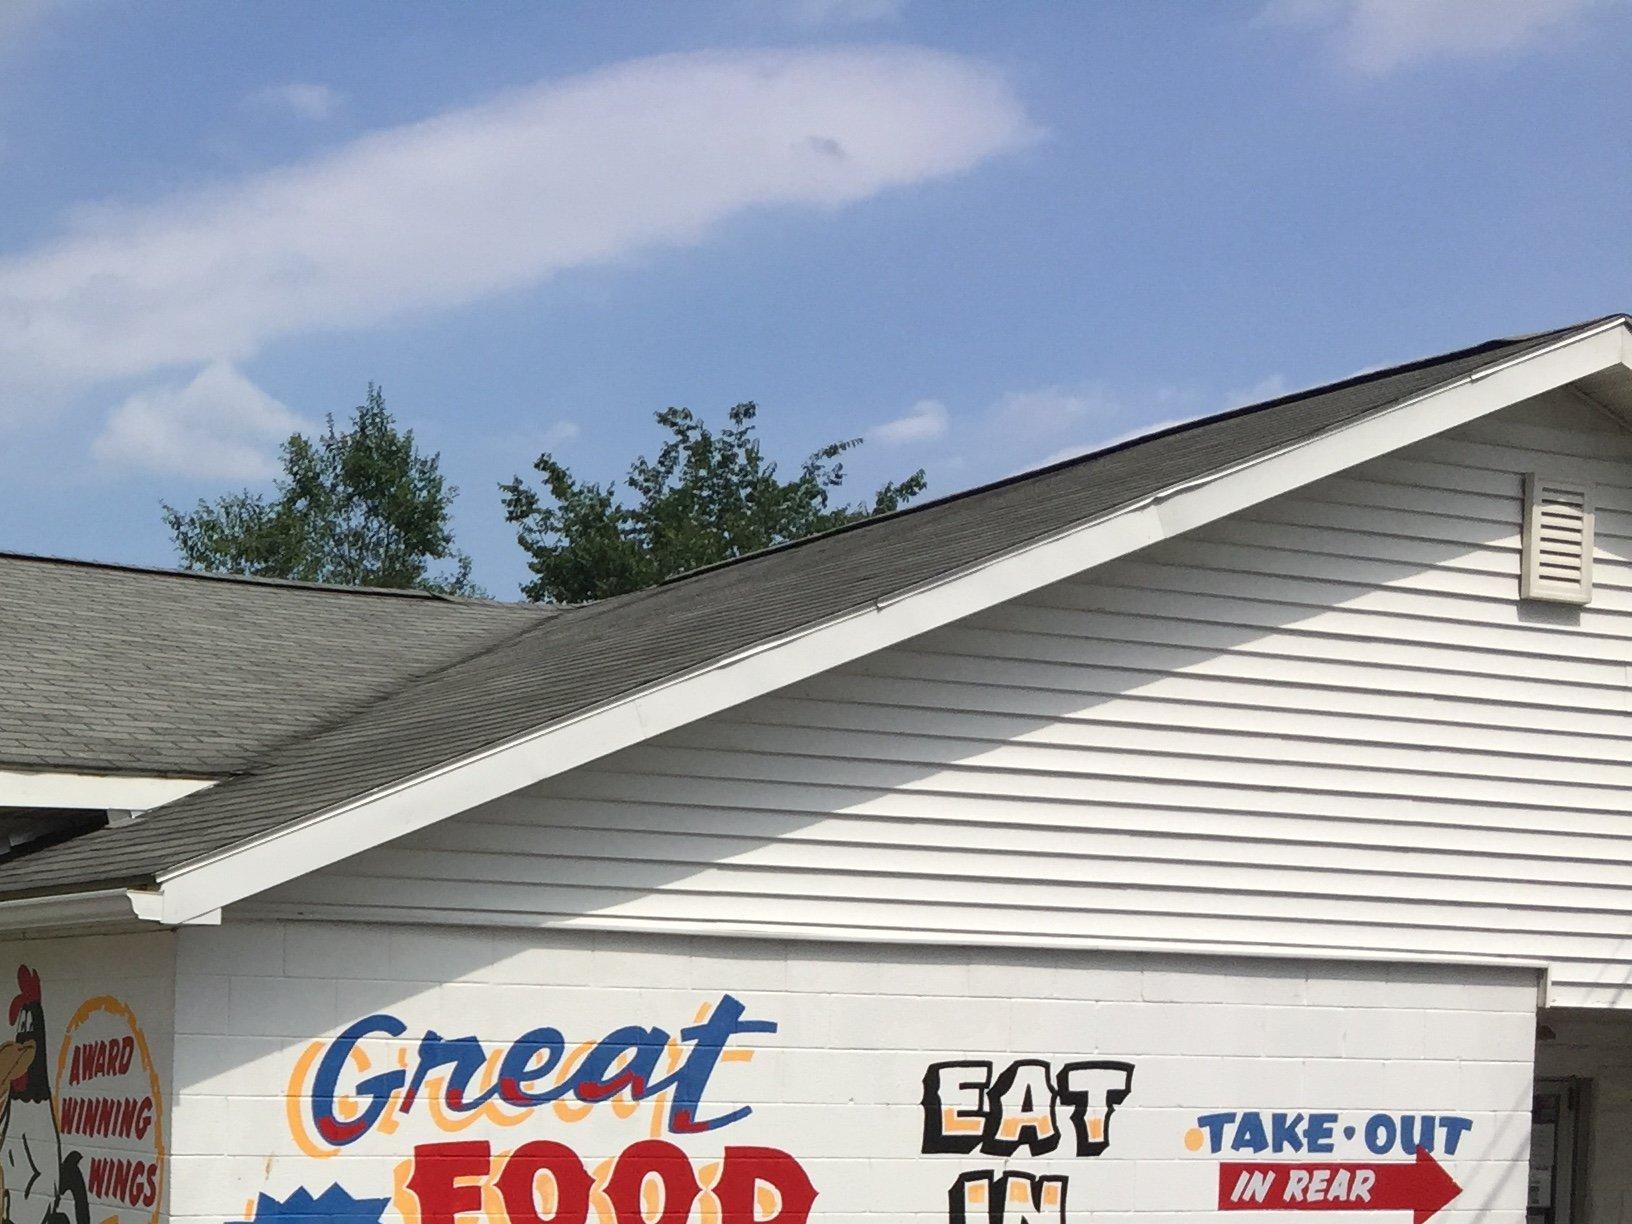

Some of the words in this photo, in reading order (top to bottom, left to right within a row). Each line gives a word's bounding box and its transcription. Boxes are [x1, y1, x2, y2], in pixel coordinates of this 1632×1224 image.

[69, 1036, 134, 1087] AWARD
[310, 994, 778, 1147] Great
[60, 1096, 153, 1141] WINNING
[922, 1059, 1135, 1157] EAT
[88, 1157, 158, 1208] WINGS
[1230, 1168, 1276, 1203] IN
[1283, 1168, 1376, 1203] REAR
